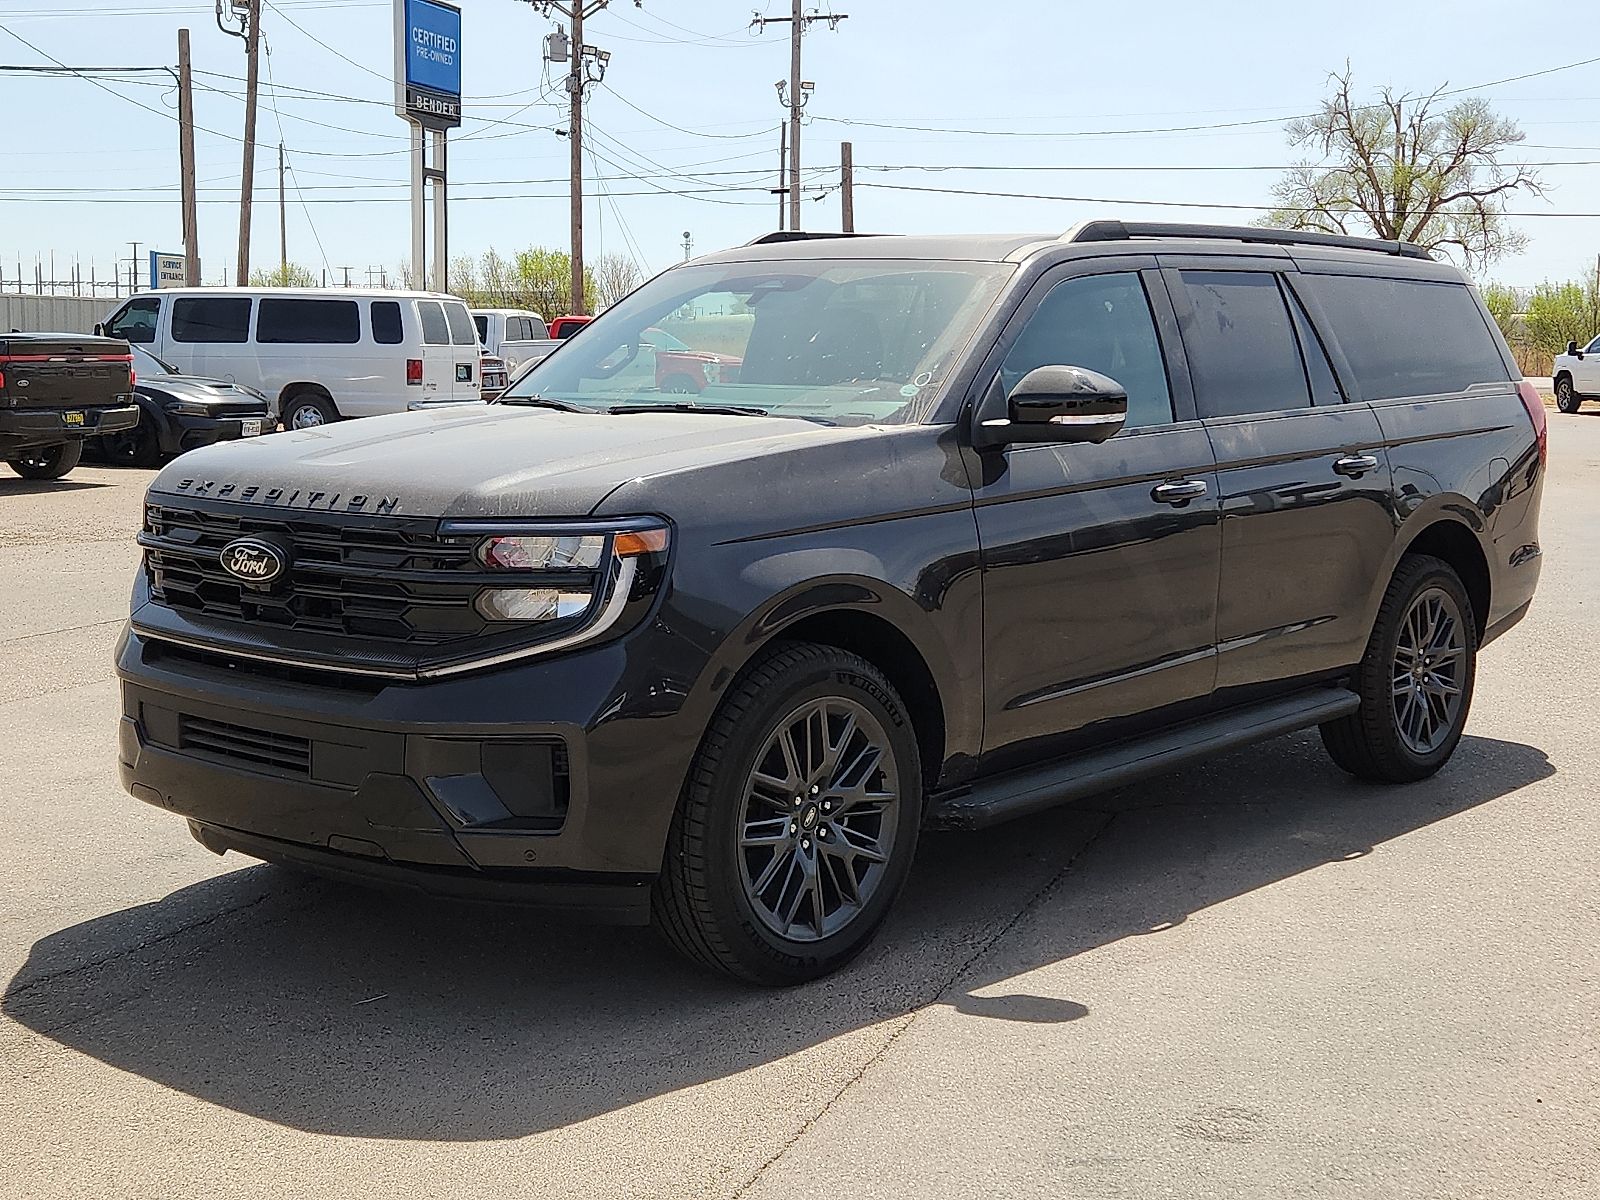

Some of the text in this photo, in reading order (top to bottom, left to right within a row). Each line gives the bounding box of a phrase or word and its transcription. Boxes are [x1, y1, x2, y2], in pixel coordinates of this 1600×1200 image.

[412, 27, 457, 53] CERTIFIED
[416, 46, 453, 66] PRE-OWNED
[416, 95, 455, 116] BENDER
[162, 260, 182, 270] SERVICE
[175, 478, 399, 514] EXPEDITION
[230, 545, 269, 576] Ford
